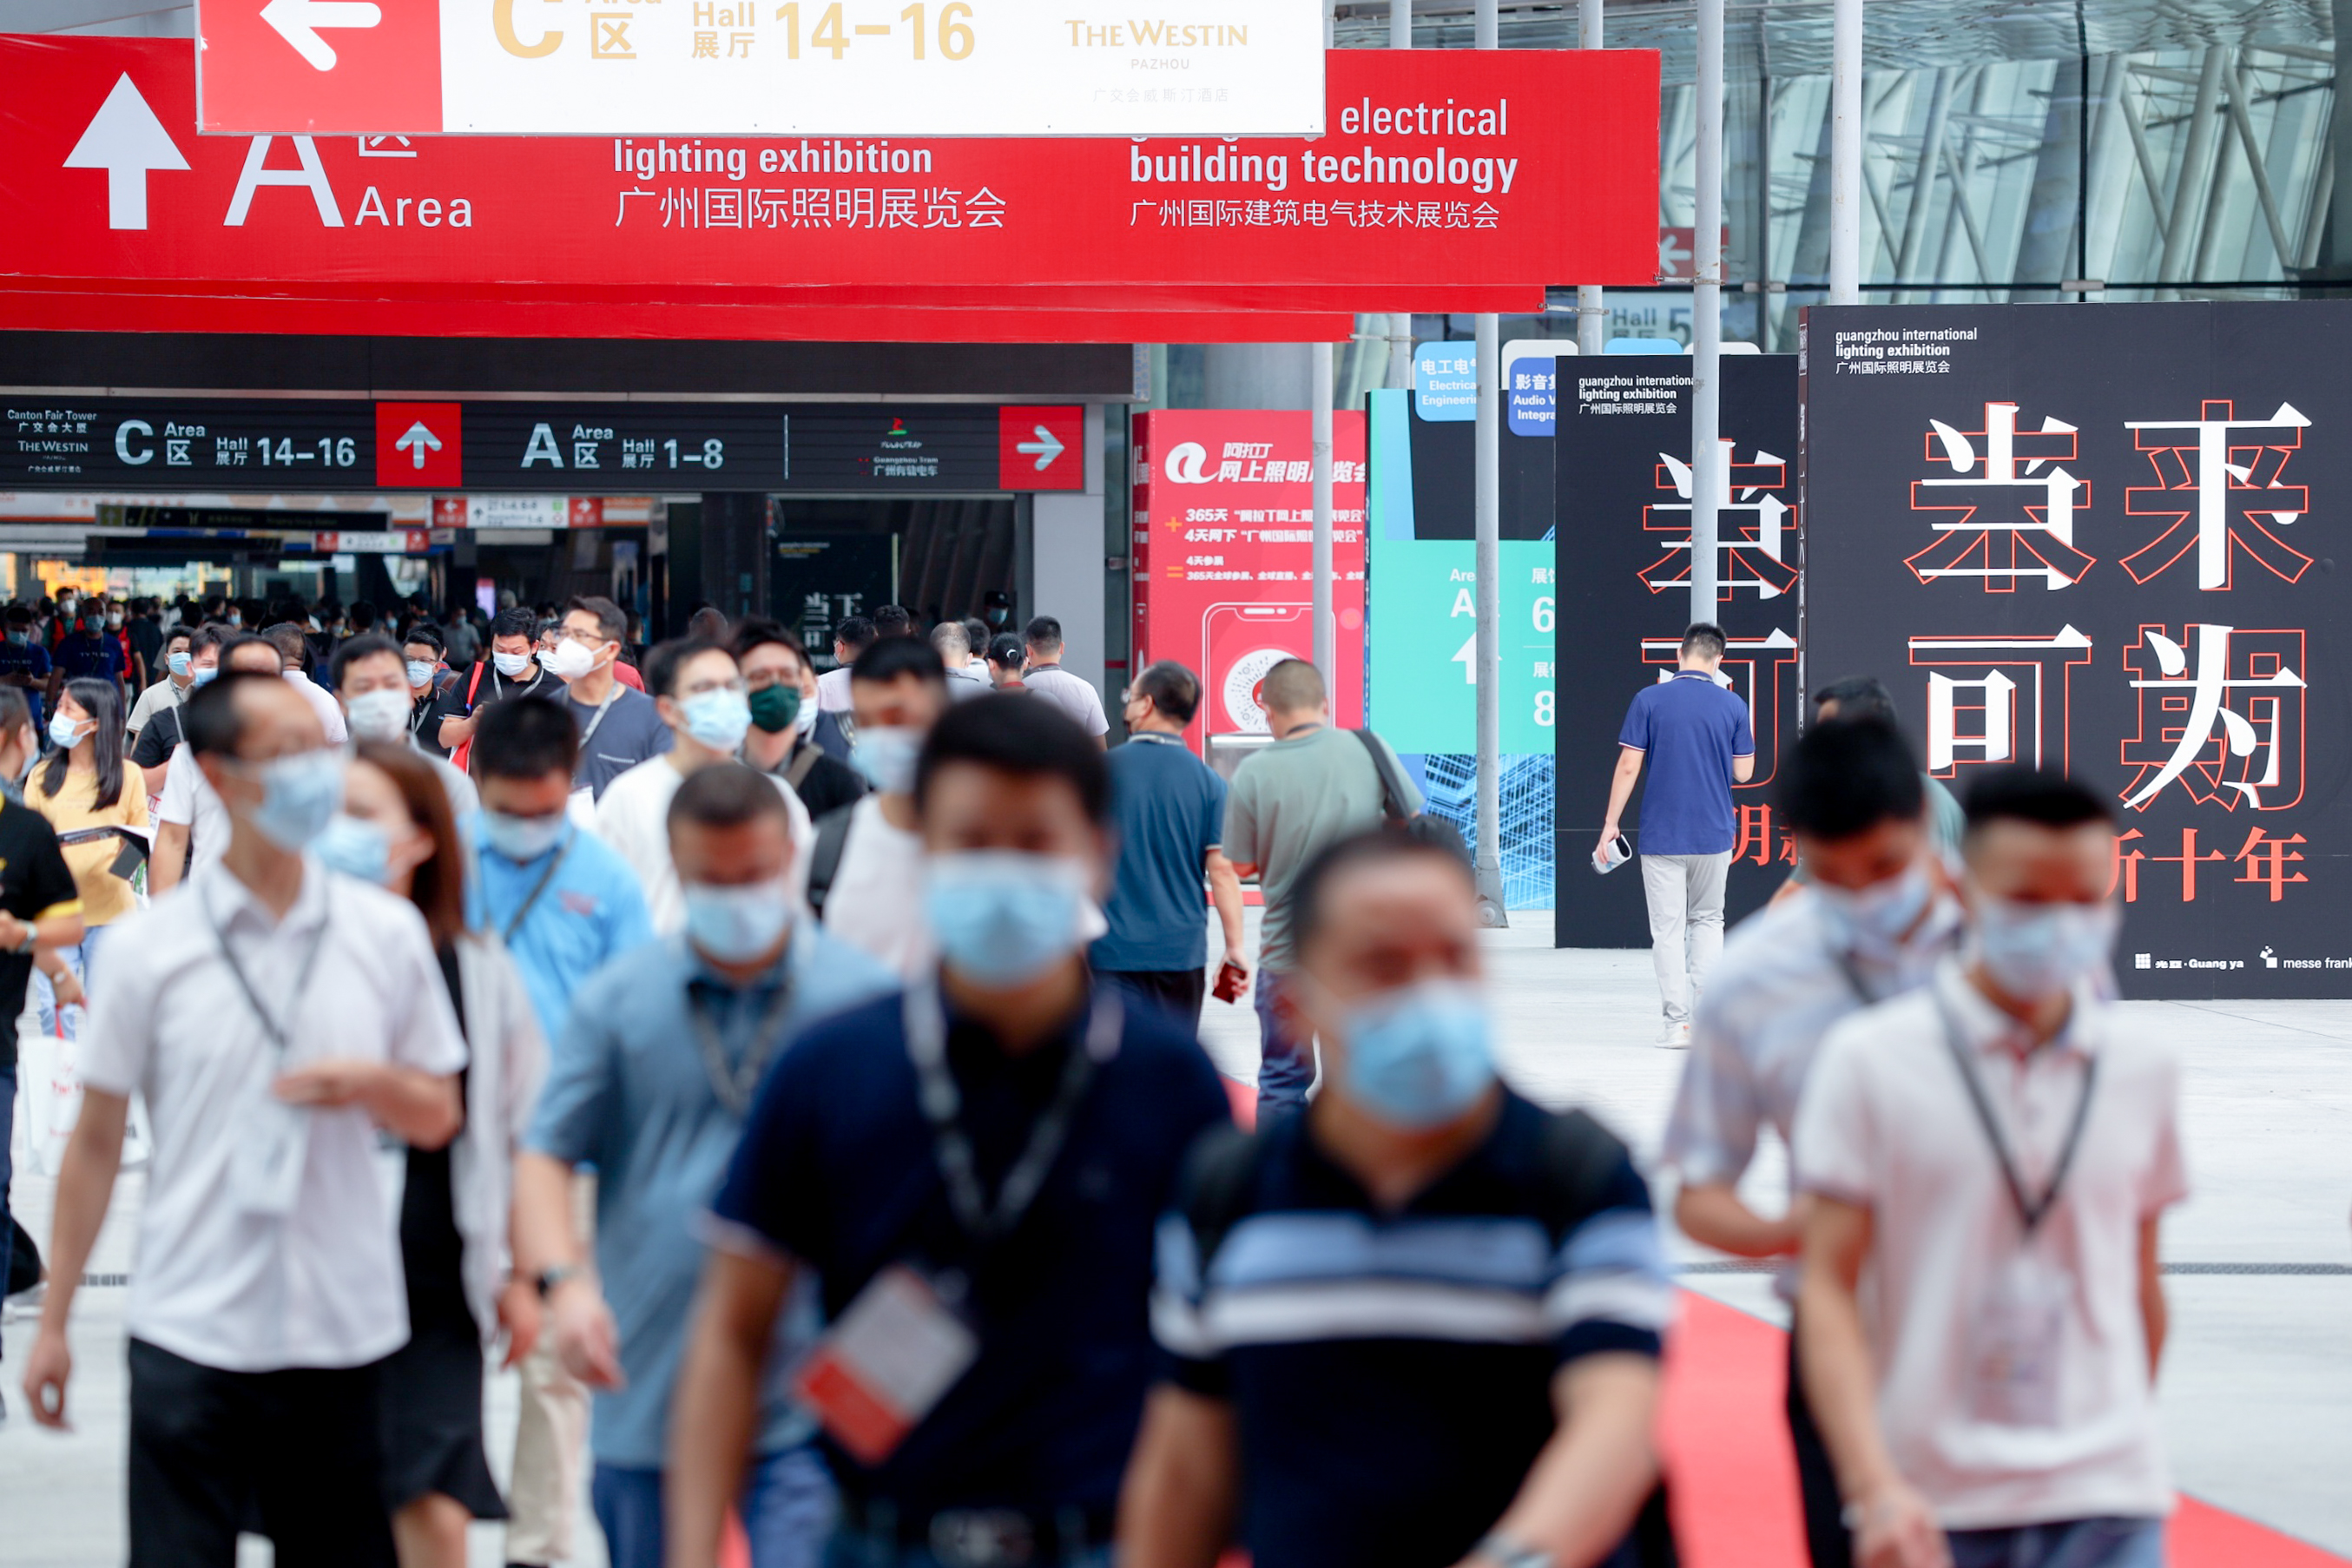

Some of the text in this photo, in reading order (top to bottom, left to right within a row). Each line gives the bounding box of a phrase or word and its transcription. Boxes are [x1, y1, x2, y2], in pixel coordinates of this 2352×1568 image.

[694, 2, 755, 27] Hall
[492, 0, 564, 59] C
[590, 12, 637, 59] 区
[775, 2, 976, 61] 14-16
[691, 31, 755, 59] 展厅
[1130, 59, 1189, 69] PAZHOU
[1092, 88, 1229, 103] 广交会威斯汀酒店
[1341, 96, 1506, 135] electrical
[614, 139, 932, 181] lighting exhibition
[1130, 145, 1518, 194] building technology
[222, 135, 345, 227] A
[353, 186, 472, 227] Area
[615, 185, 1006, 228] 广州国际照明展览会
[1130, 199, 1499, 228] 广州国际建筑电气技术展览会
[1612, 307, 1657, 326] Hall
[1835, 326, 1978, 344] guangzhou international
[1835, 343, 1950, 359] lighting exhibition
[1835, 360, 1951, 374] 广州国际照明展览会
[1578, 375, 1633, 388] guangzhou
[1513, 395, 1546, 406] Audio
[1578, 388, 1677, 402] lighting exhibition
[7, 409, 98, 421] Canton Fair Tower
[1578, 403, 1677, 415] 广州国际照明展览会
[18, 421, 88, 433] 广交会大厦
[164, 422, 206, 437] Area
[572, 424, 614, 439] Area
[17, 440, 89, 452] THE WESTIN
[115, 419, 154, 465] C
[216, 437, 248, 451] Hall
[521, 423, 564, 468] A
[623, 438, 655, 452] Hall
[1222, 442, 1274, 458] 阿拉丁
[167, 439, 192, 465] 区
[215, 451, 248, 465] 展厅
[257, 437, 356, 467] 14-16
[575, 442, 600, 469] 区
[622, 453, 655, 468] 展厅
[663, 438, 724, 469] 1-8
[1218, 460, 1367, 483] 网上照明览
[2229, 959, 2244, 971] ya
[2283, 959, 2322, 969] messe
